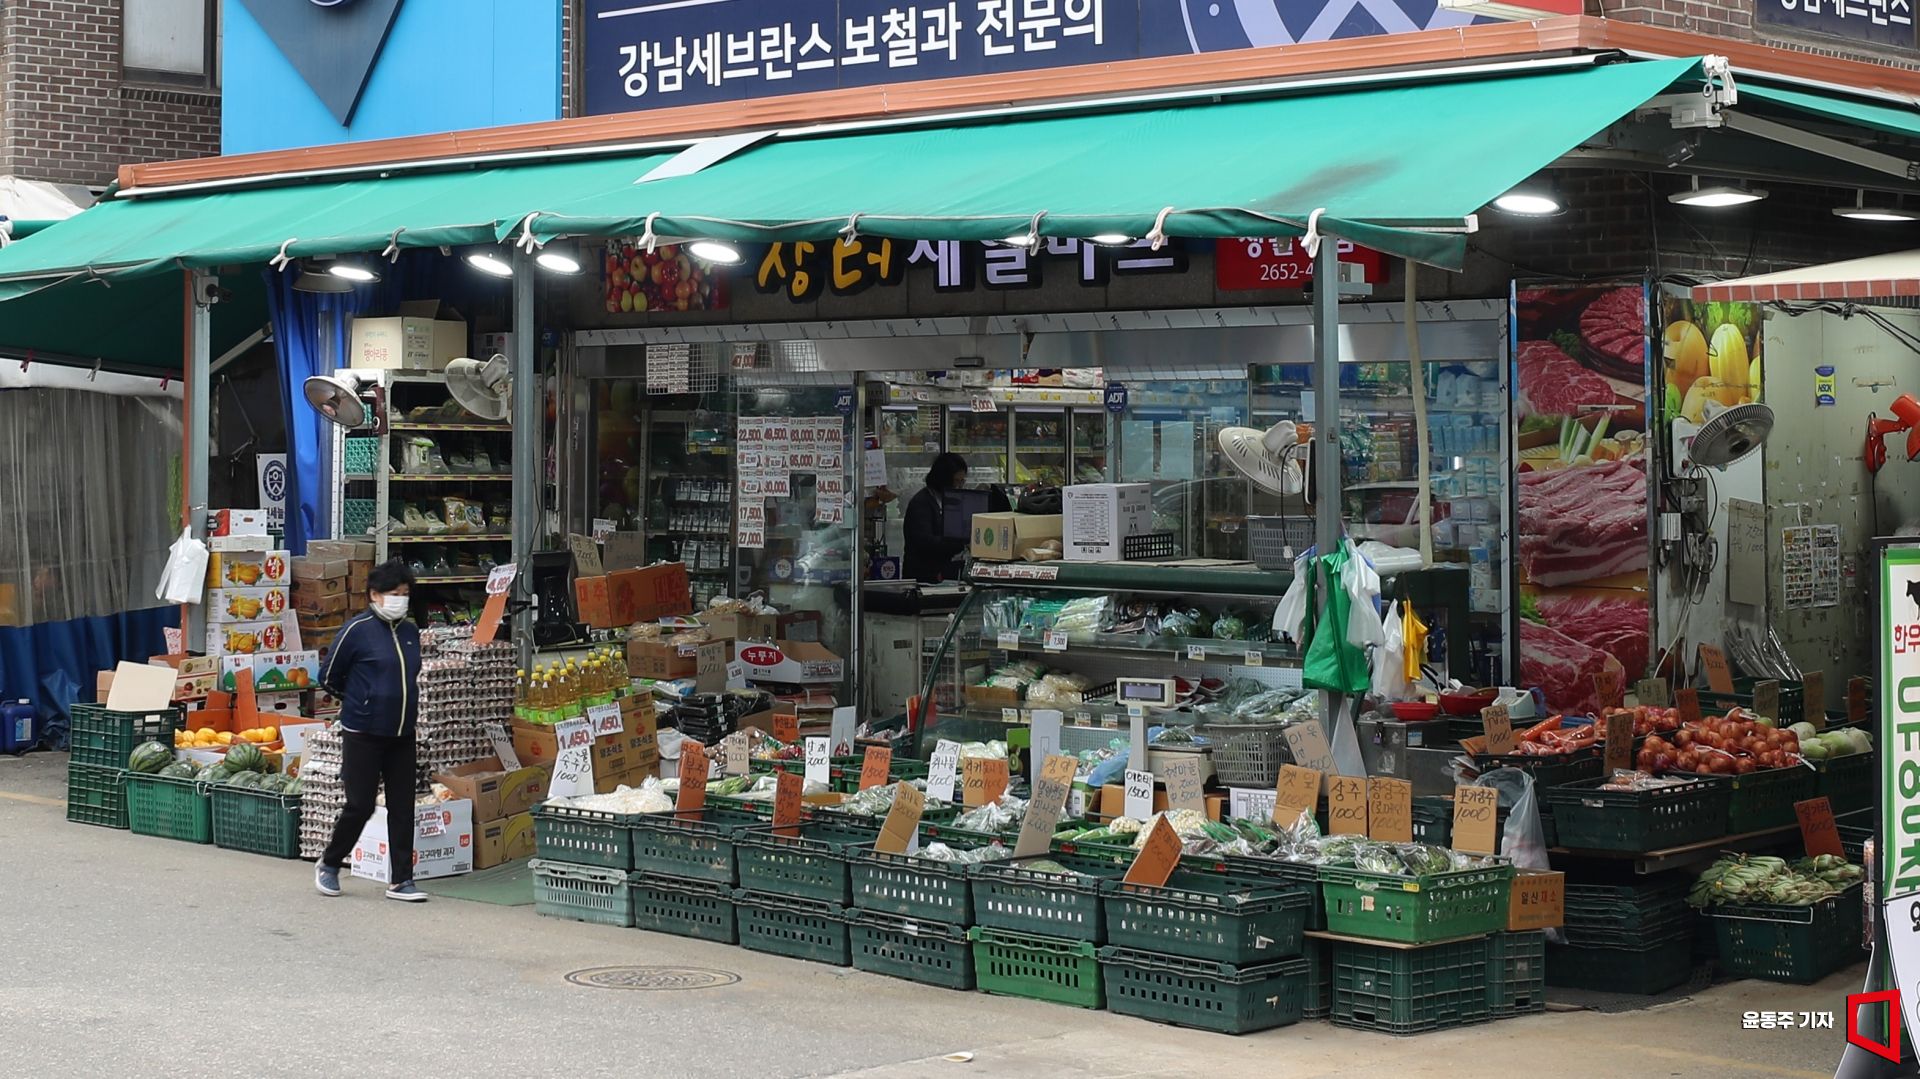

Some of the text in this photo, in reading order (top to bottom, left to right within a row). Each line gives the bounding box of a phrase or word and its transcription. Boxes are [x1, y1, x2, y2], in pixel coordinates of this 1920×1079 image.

[976, 0, 1103, 56] 전문의
[836, 395, 852, 407] ADT
[1107, 392, 1124, 404] ADT
[747, 649, 777, 663] 누룽지
[1127, 785, 1149, 800] 1500
[1330, 780, 1362, 801] 상추
[1459, 787, 1496, 806] 포기상추
[1329, 805, 1365, 820] 1000
